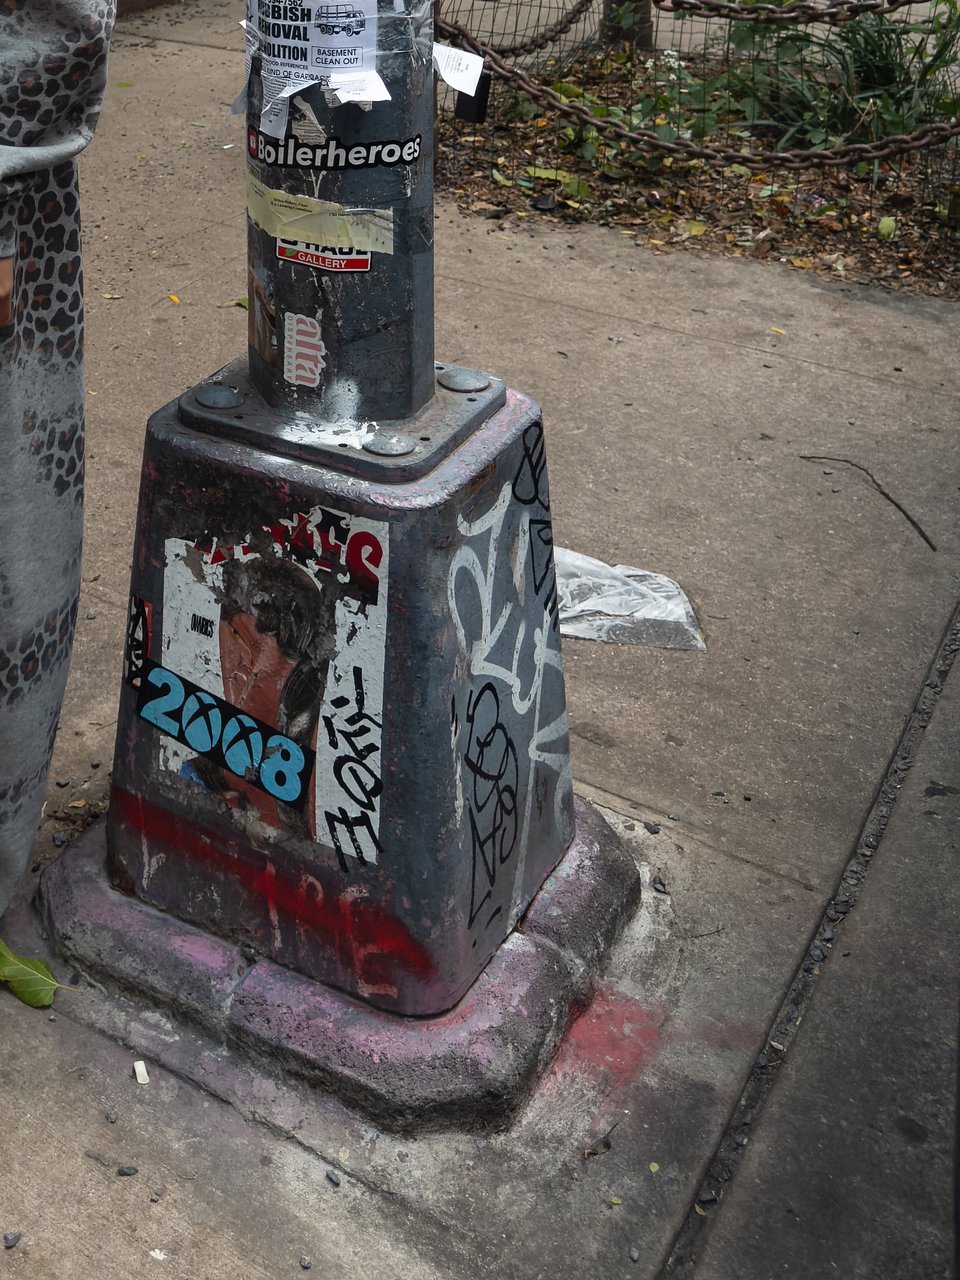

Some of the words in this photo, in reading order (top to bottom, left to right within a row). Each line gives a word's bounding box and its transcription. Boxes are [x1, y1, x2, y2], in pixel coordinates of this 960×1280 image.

[258, 17, 310, 42] REMOVAL
[260, 39, 308, 62] OLITION
[317, 48, 357, 57] BASEMENT
[280, 61, 308, 70] REFERENCES
[315, 56, 341, 65] CLEAN
[342, 57, 359, 65] OUT
[282, 70, 292, 78] OF
[258, 135, 420, 167] Boilerheroes
[298, 252, 347, 269] GALLERY
[296, 318, 322, 384] alta
